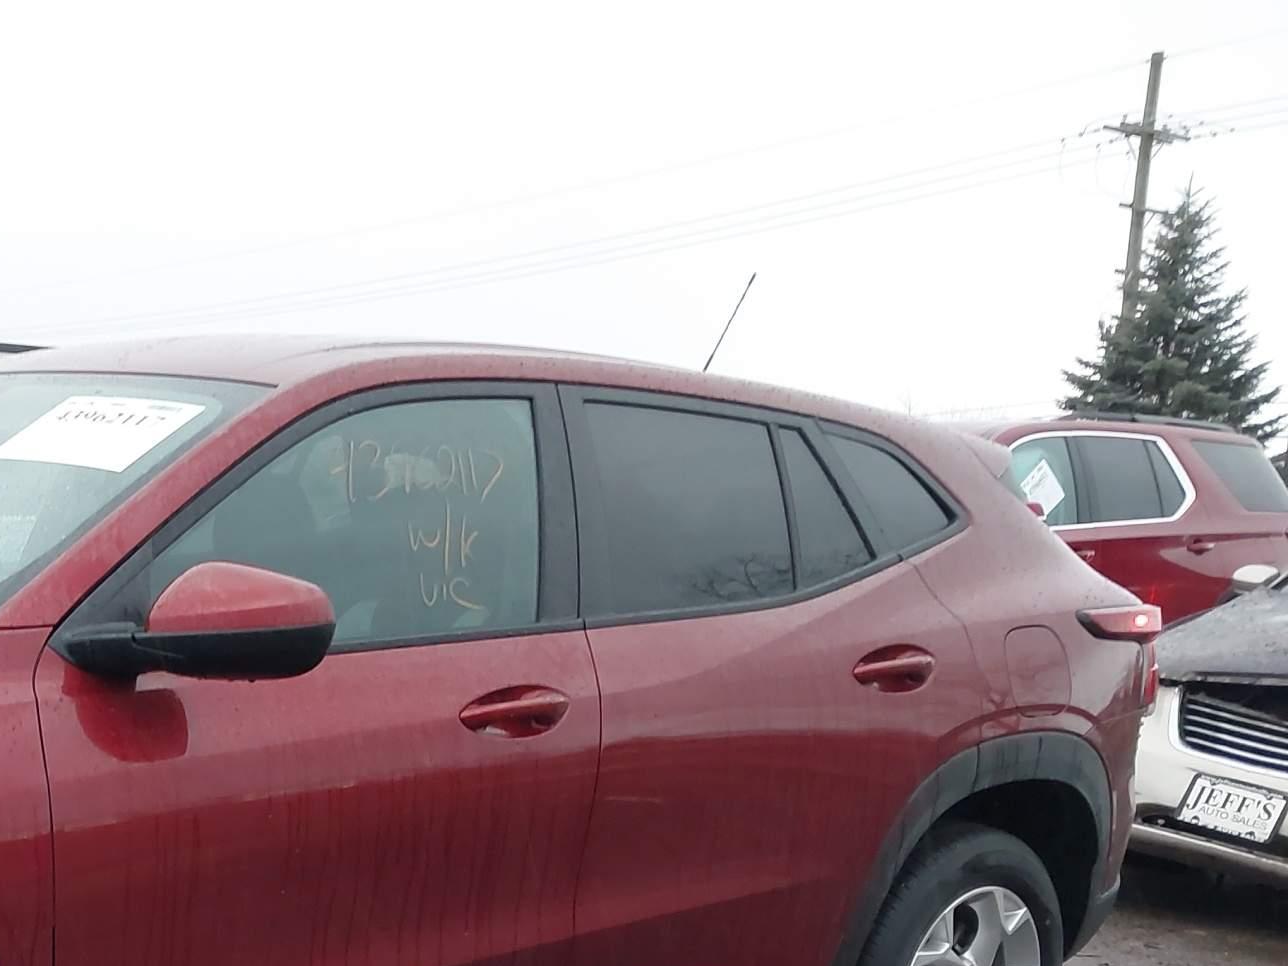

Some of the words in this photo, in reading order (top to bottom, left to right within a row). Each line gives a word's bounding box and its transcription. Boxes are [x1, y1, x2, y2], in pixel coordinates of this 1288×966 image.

[1186, 785, 1277, 822] JEFF'S
[1198, 805, 1230, 820] AUTO
[1232, 813, 1269, 831] SALES
